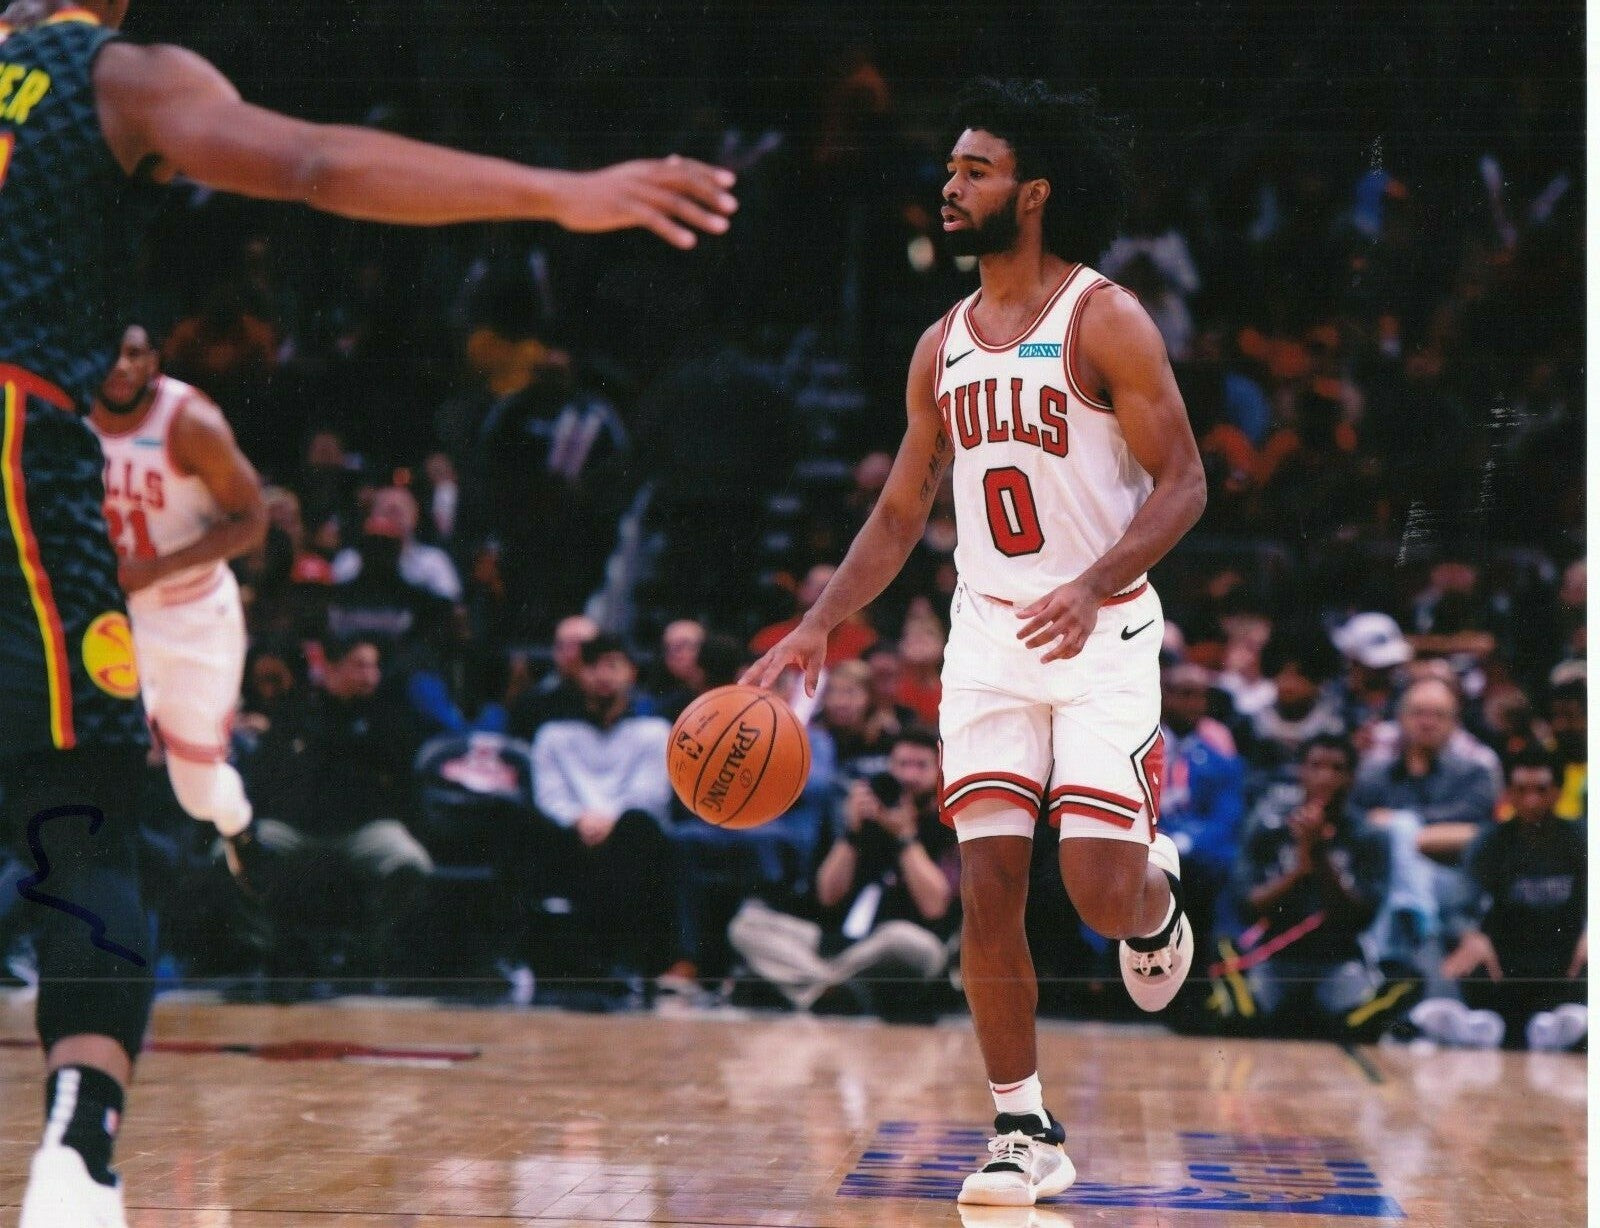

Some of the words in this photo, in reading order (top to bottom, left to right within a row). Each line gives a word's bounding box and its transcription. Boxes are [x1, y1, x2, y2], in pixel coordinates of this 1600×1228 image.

[0, 63, 51, 126] ER
[983, 465, 1046, 558] 0
[701, 721, 761, 812] SPALDING
